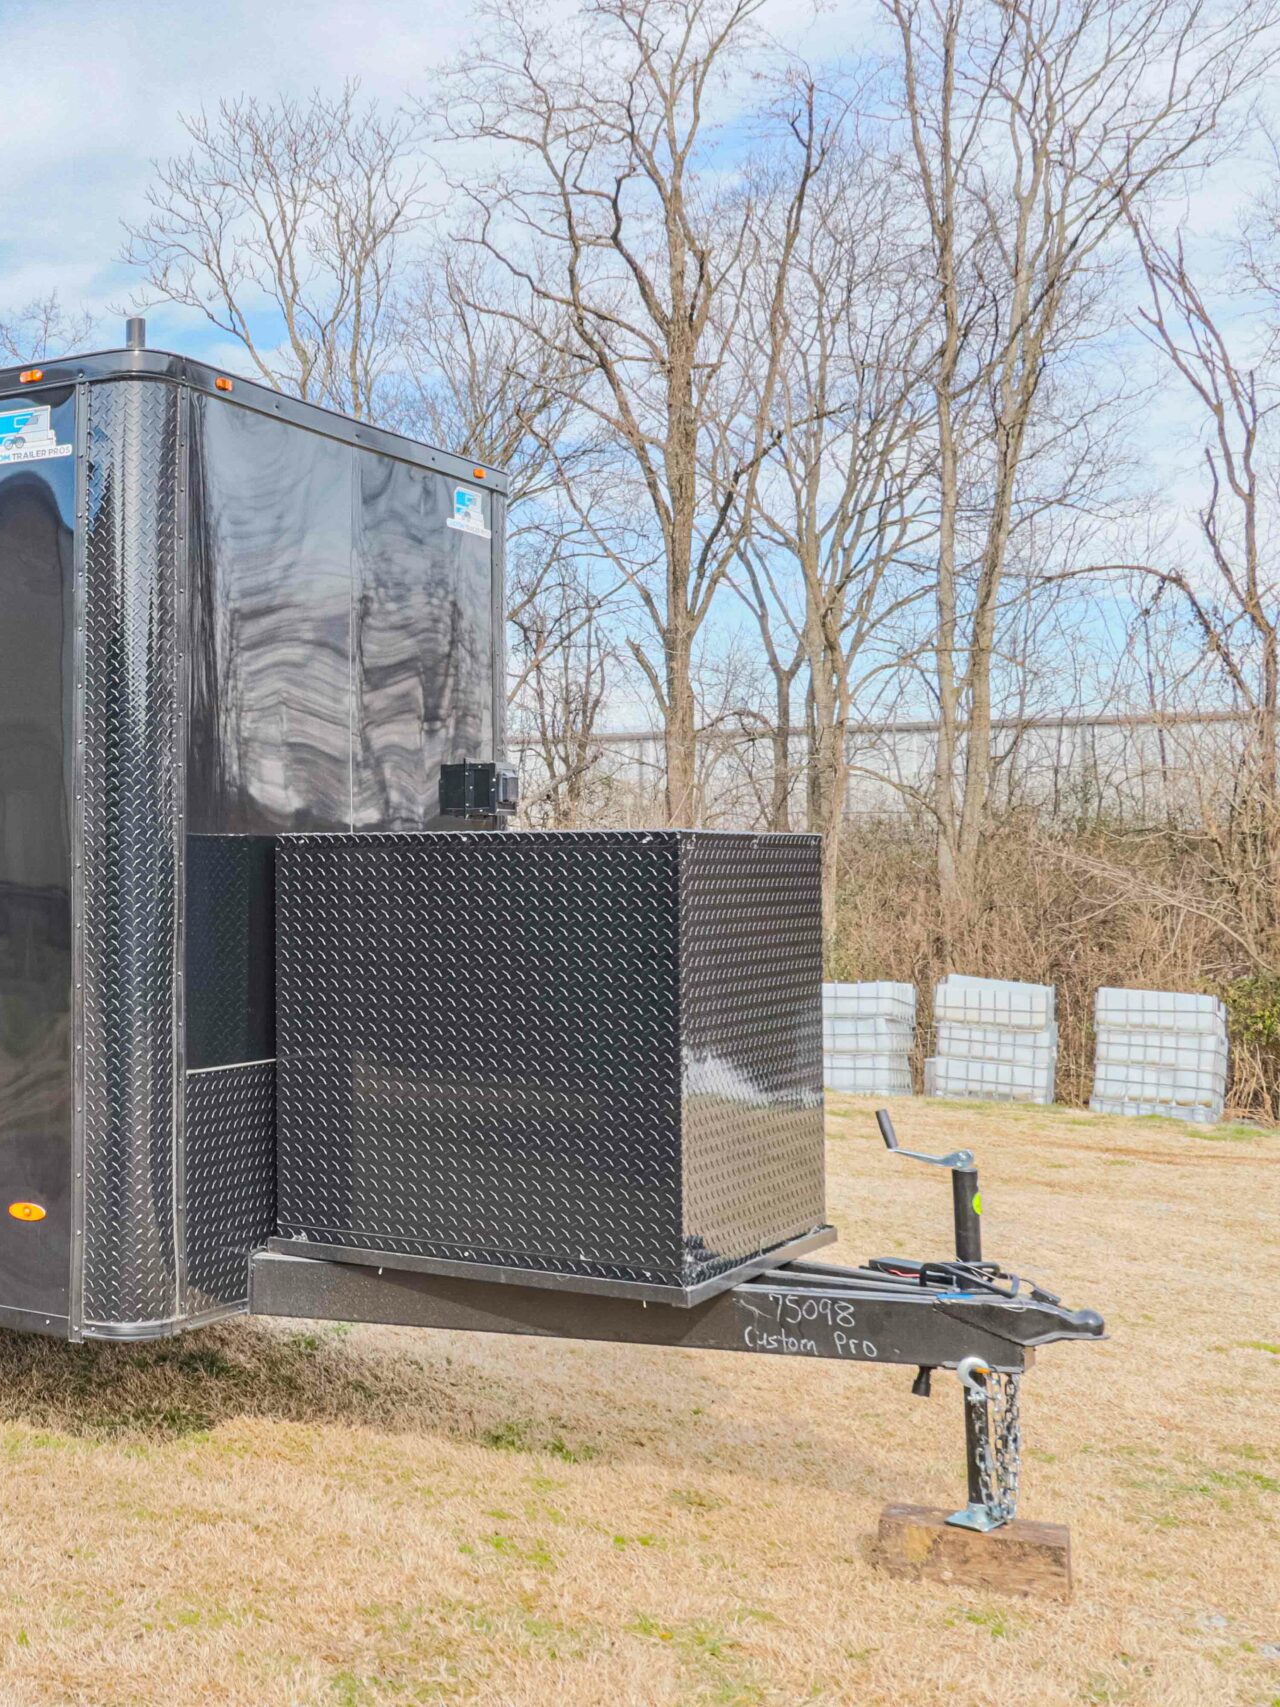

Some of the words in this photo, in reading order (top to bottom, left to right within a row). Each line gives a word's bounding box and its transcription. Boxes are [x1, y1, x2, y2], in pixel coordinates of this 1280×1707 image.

[12, 449, 47, 461] TRAILER
[48, 446, 71, 456] PROS
[769, 1294, 855, 1327] 75098
[745, 1326, 818, 1355] Custom
[834, 1331, 877, 1358] Pro
